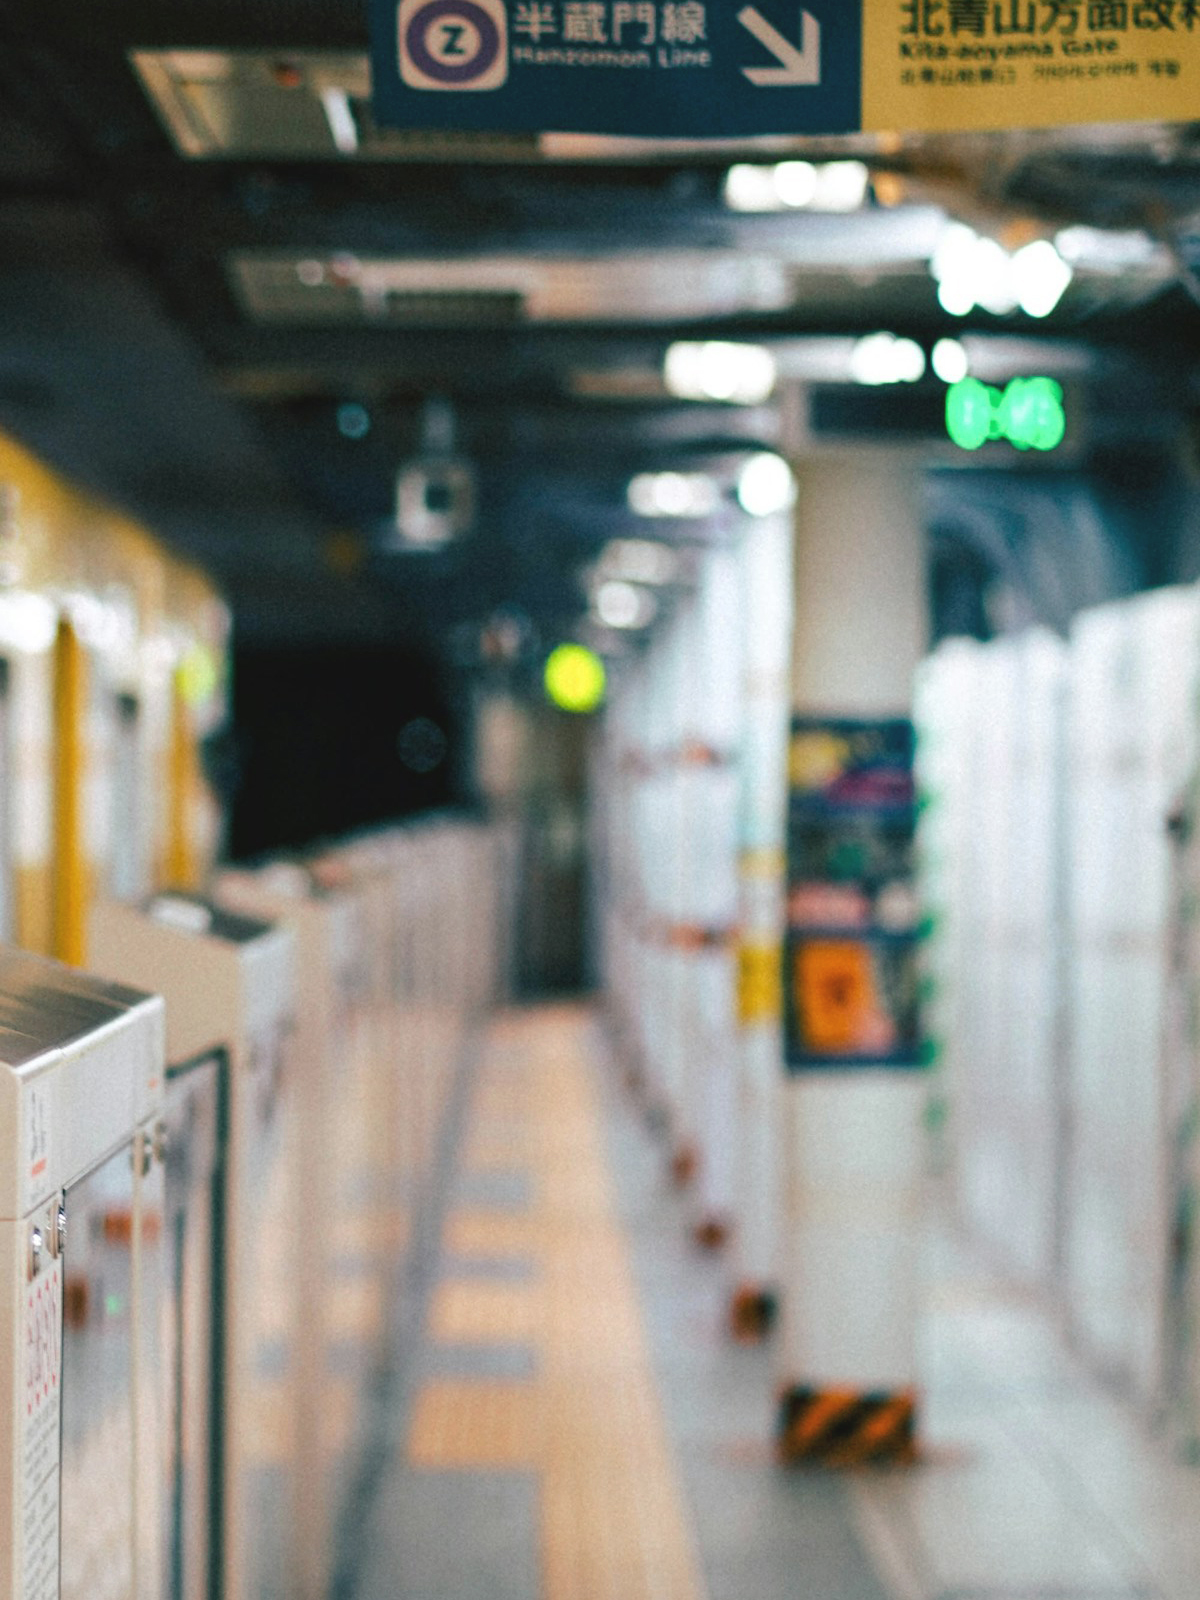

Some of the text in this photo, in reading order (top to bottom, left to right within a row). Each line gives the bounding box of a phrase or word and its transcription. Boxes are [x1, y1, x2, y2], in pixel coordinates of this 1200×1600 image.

[513, 1, 708, 44] 半蔵門線
[441, 26, 464, 54] Z
[1061, 38, 1117, 55] Gate
[513, 48, 711, 67] Hanzomon Line
